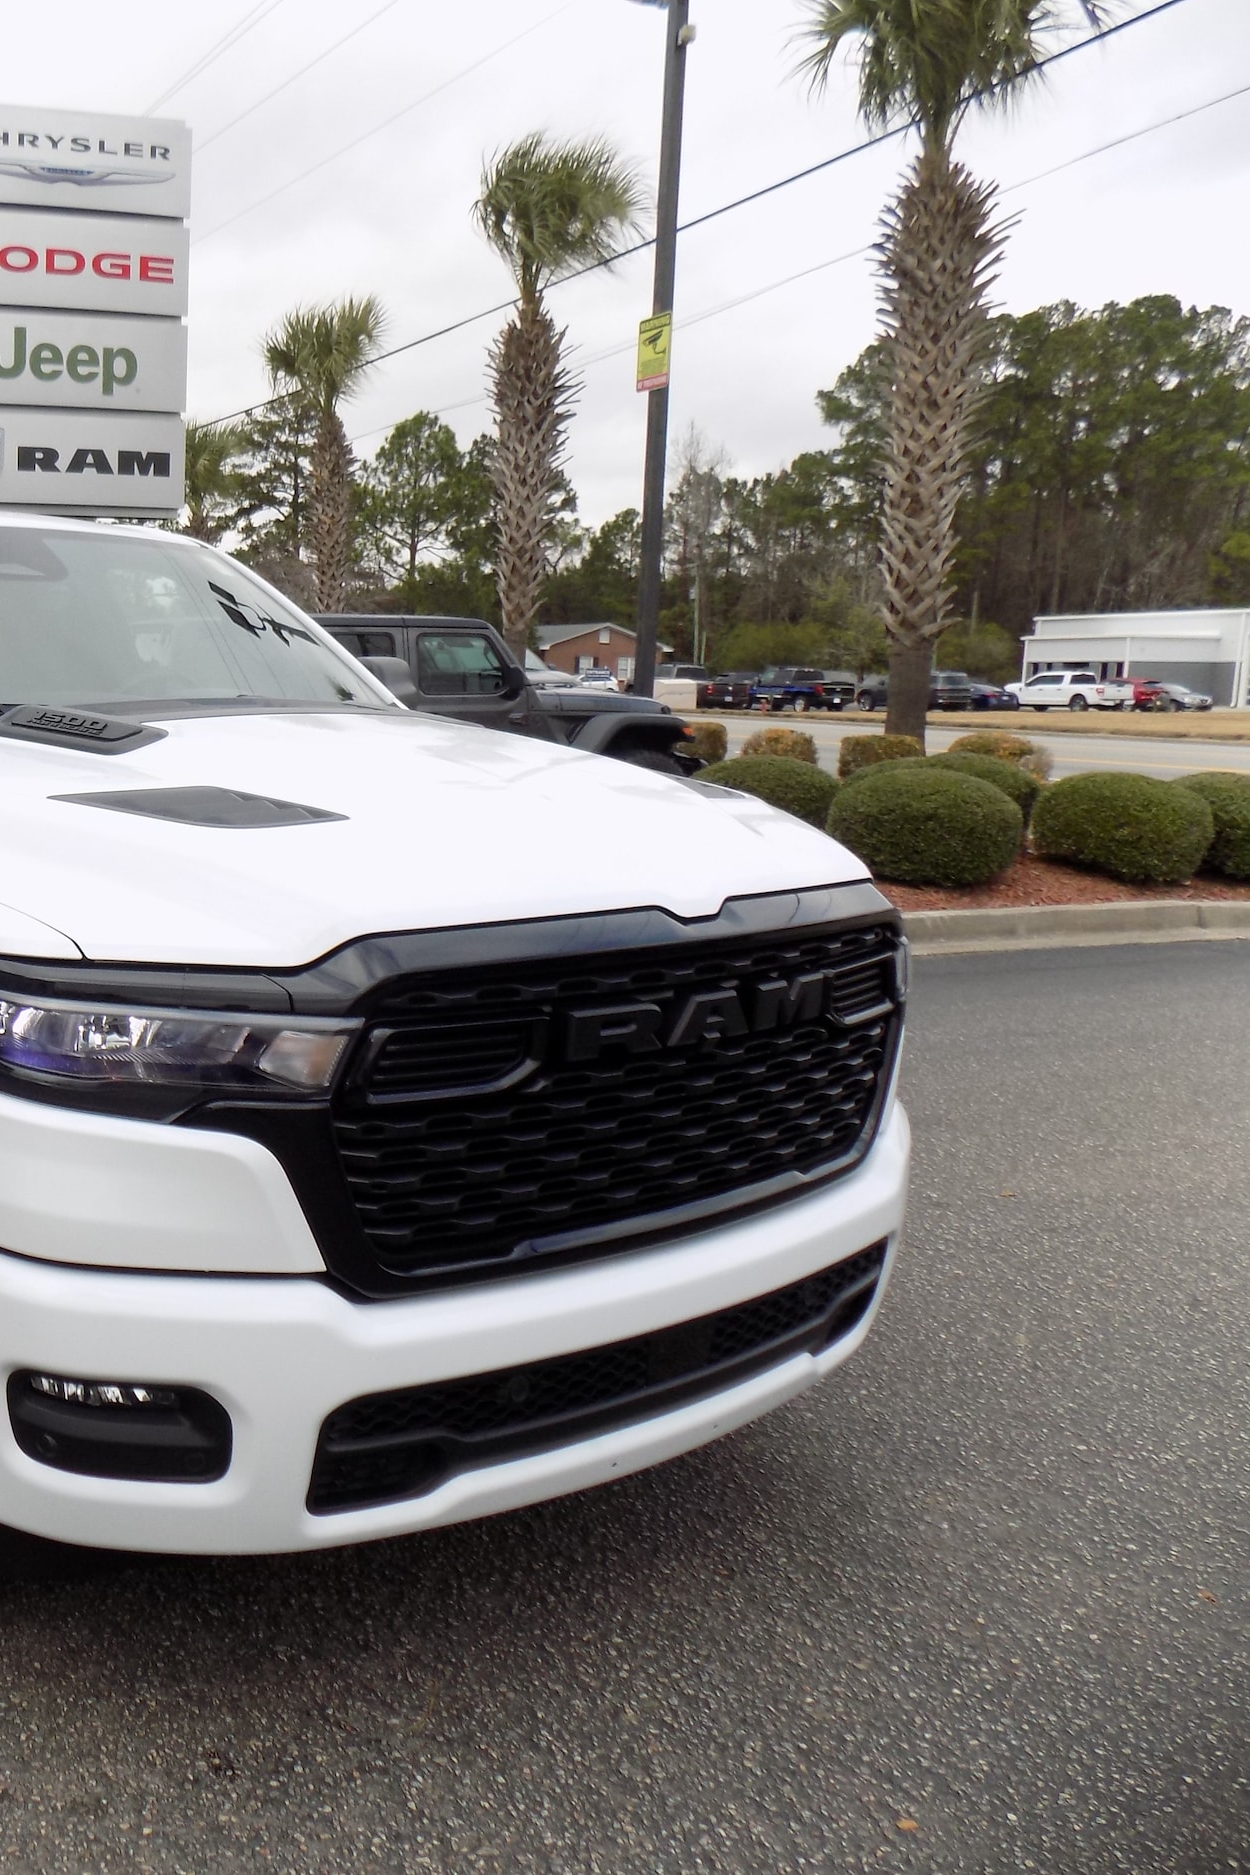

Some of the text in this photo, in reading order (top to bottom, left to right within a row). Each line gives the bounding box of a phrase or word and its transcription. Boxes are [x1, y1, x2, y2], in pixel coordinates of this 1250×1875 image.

[16, 445, 171, 478] RAM
[33, 710, 108, 731] 1500
[566, 971, 824, 1062] RAM
